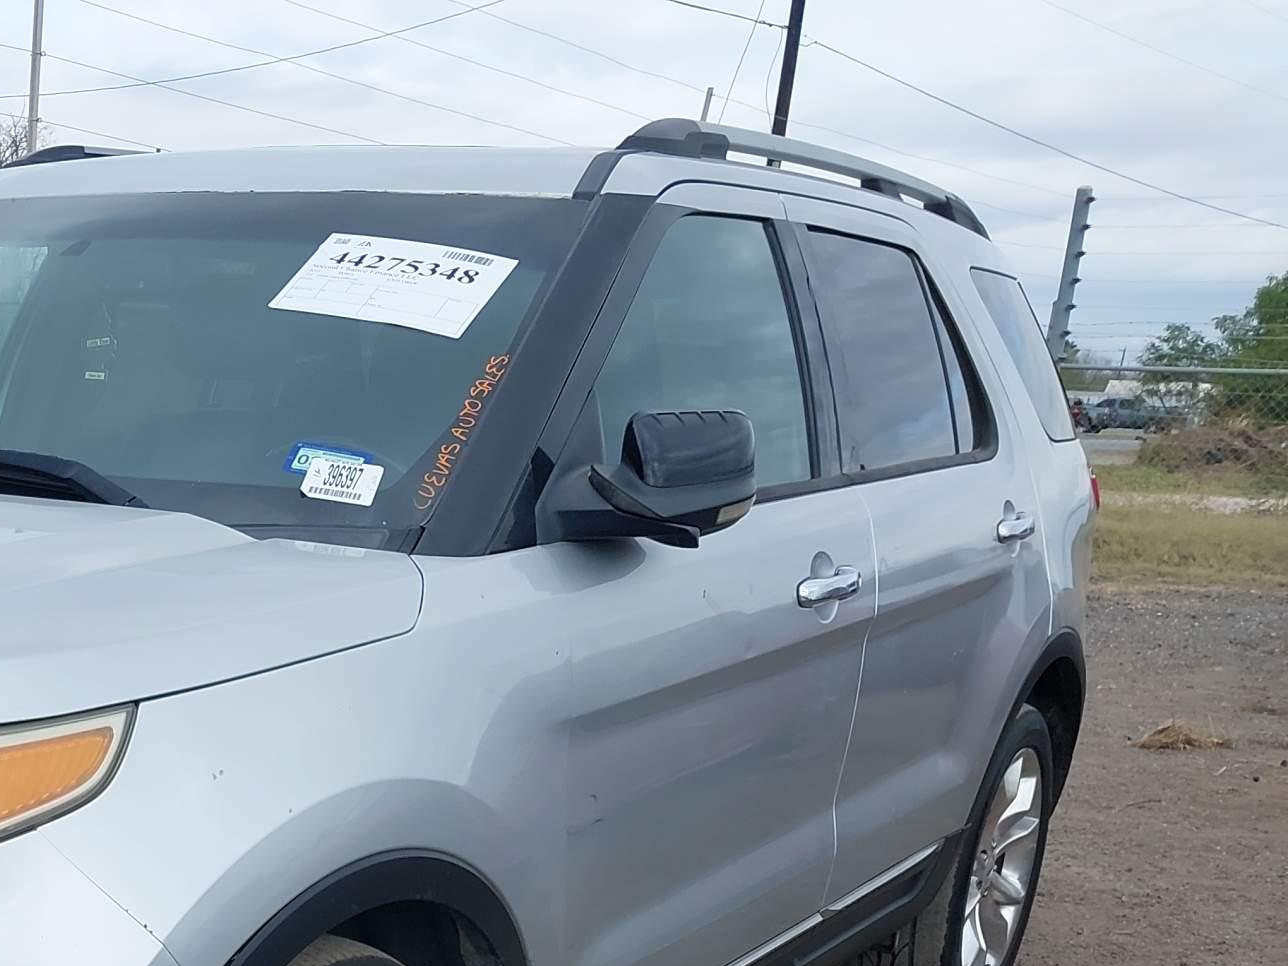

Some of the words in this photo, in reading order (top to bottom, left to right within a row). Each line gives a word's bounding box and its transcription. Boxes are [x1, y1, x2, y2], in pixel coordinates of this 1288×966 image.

[329, 251, 480, 285] 44275348
[413, 443, 460, 509] CUEVAS
[451, 399, 482, 441] AUTO
[323, 463, 364, 491] 396397
